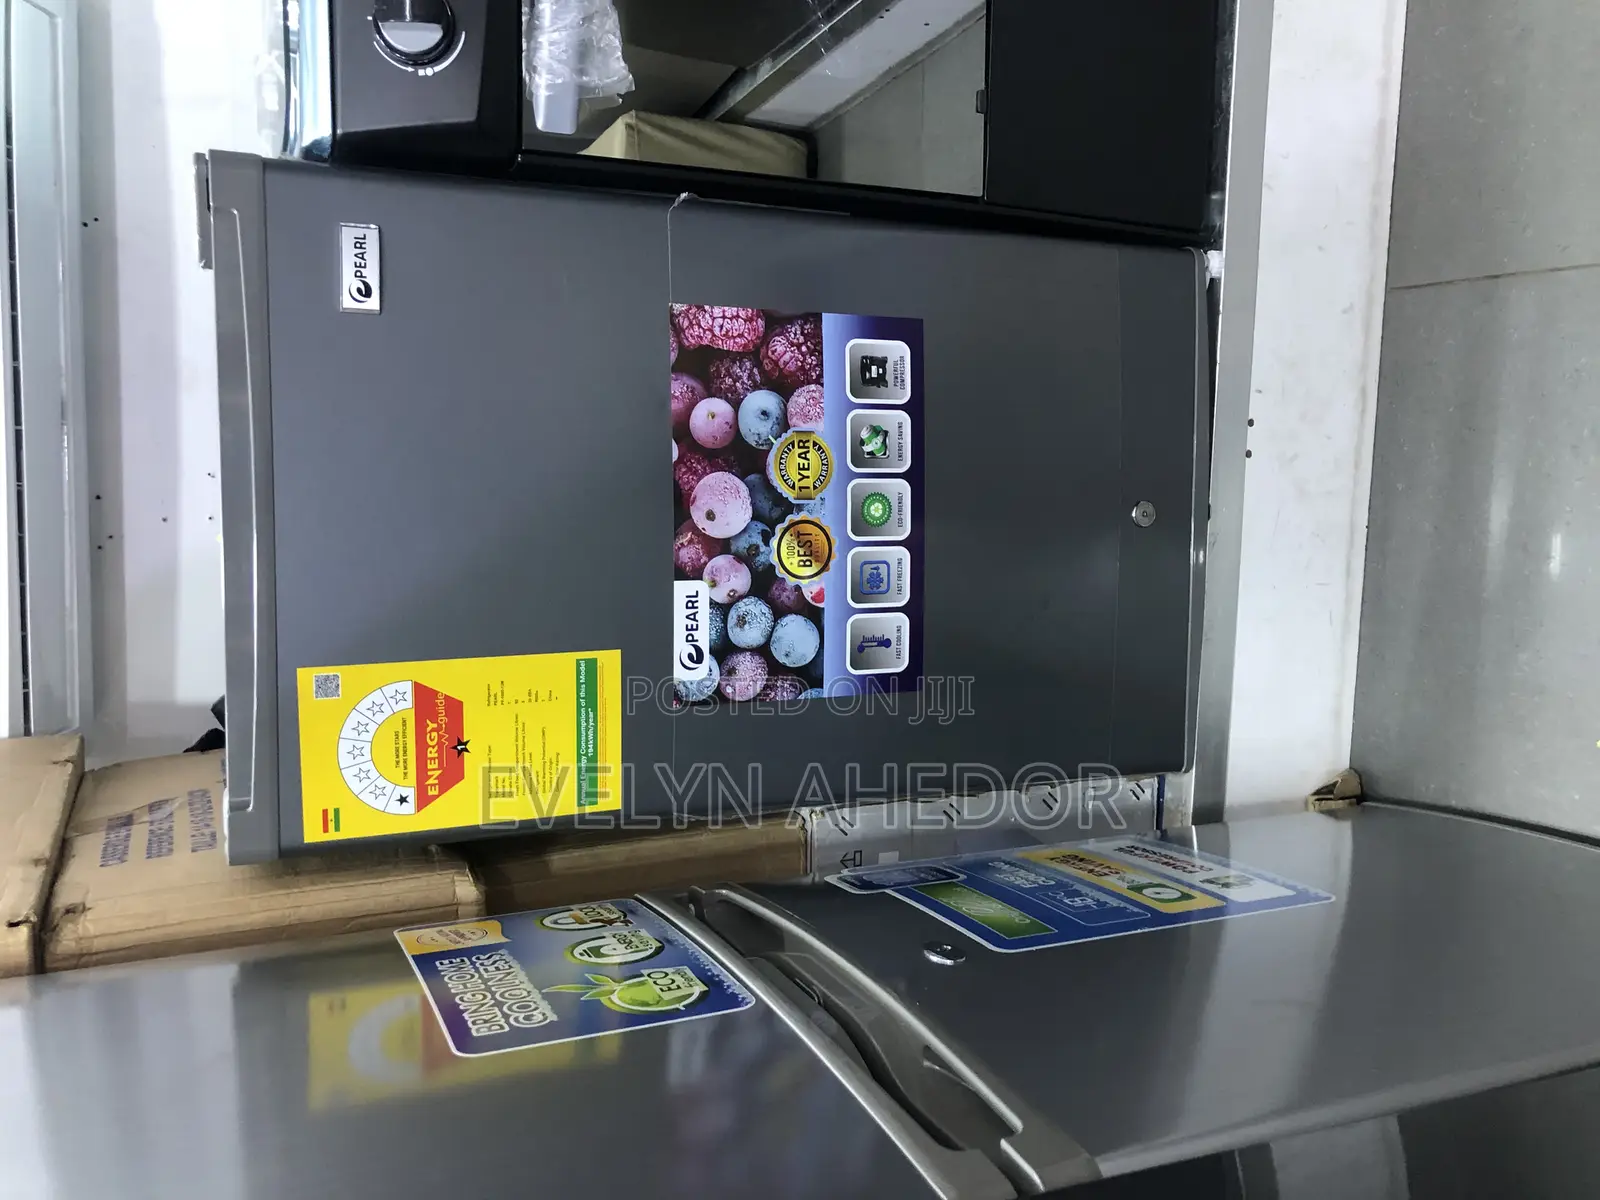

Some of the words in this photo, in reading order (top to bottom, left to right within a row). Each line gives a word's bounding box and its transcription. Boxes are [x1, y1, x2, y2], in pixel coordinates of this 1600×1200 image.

[353, 233, 368, 279] PEARL
[778, 443, 794, 487] WARRANTY
[797, 438, 810, 484] YEAR
[812, 443, 829, 488] WARRANTY
[786, 538, 796, 560] 100%
[797, 530, 813, 568] BEST
[685, 590, 699, 644] PEARL
[435, 692, 448, 723] guide
[425, 719, 443, 796] ENERGY
[580, 755, 588, 779] Energy
[435, 956, 487, 994] HOME
[472, 950, 551, 1028] COOLNESS
[646, 970, 682, 993] ECO
[454, 991, 511, 1037] BRING
